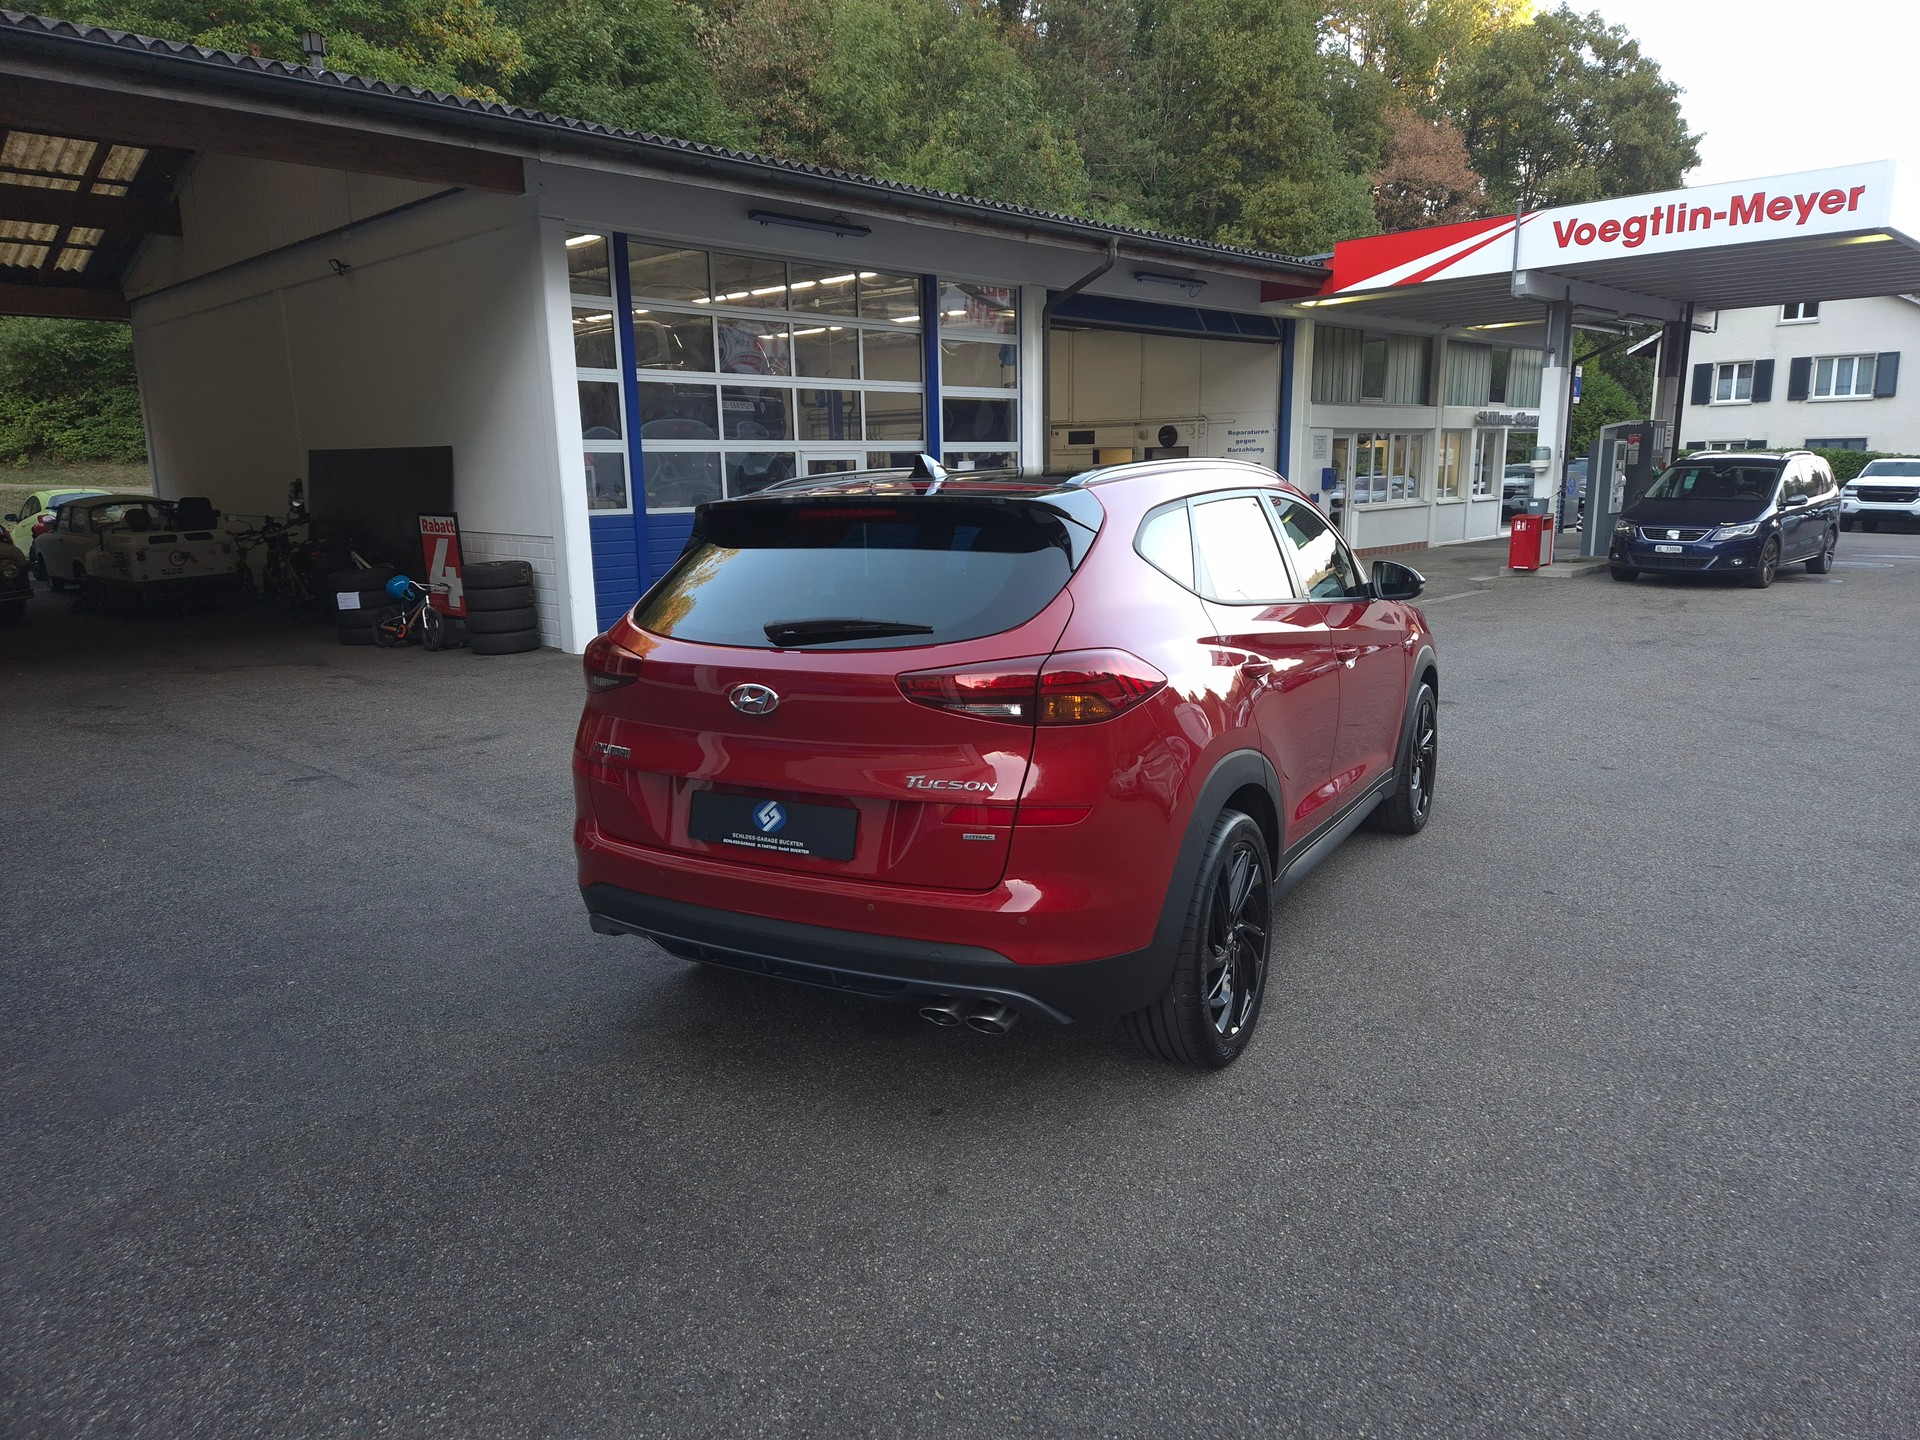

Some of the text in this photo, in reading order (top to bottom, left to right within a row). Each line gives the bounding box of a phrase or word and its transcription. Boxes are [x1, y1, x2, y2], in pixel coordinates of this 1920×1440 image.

[1552, 185, 1866, 249] Voegtlin-Meyer
[420, 518, 456, 534] Rabatt
[429, 538, 464, 610] 4
[905, 775, 999, 792] TUCSON
[732, 832, 804, 848] SCHLOSS-GARAGE BUCKTEN
